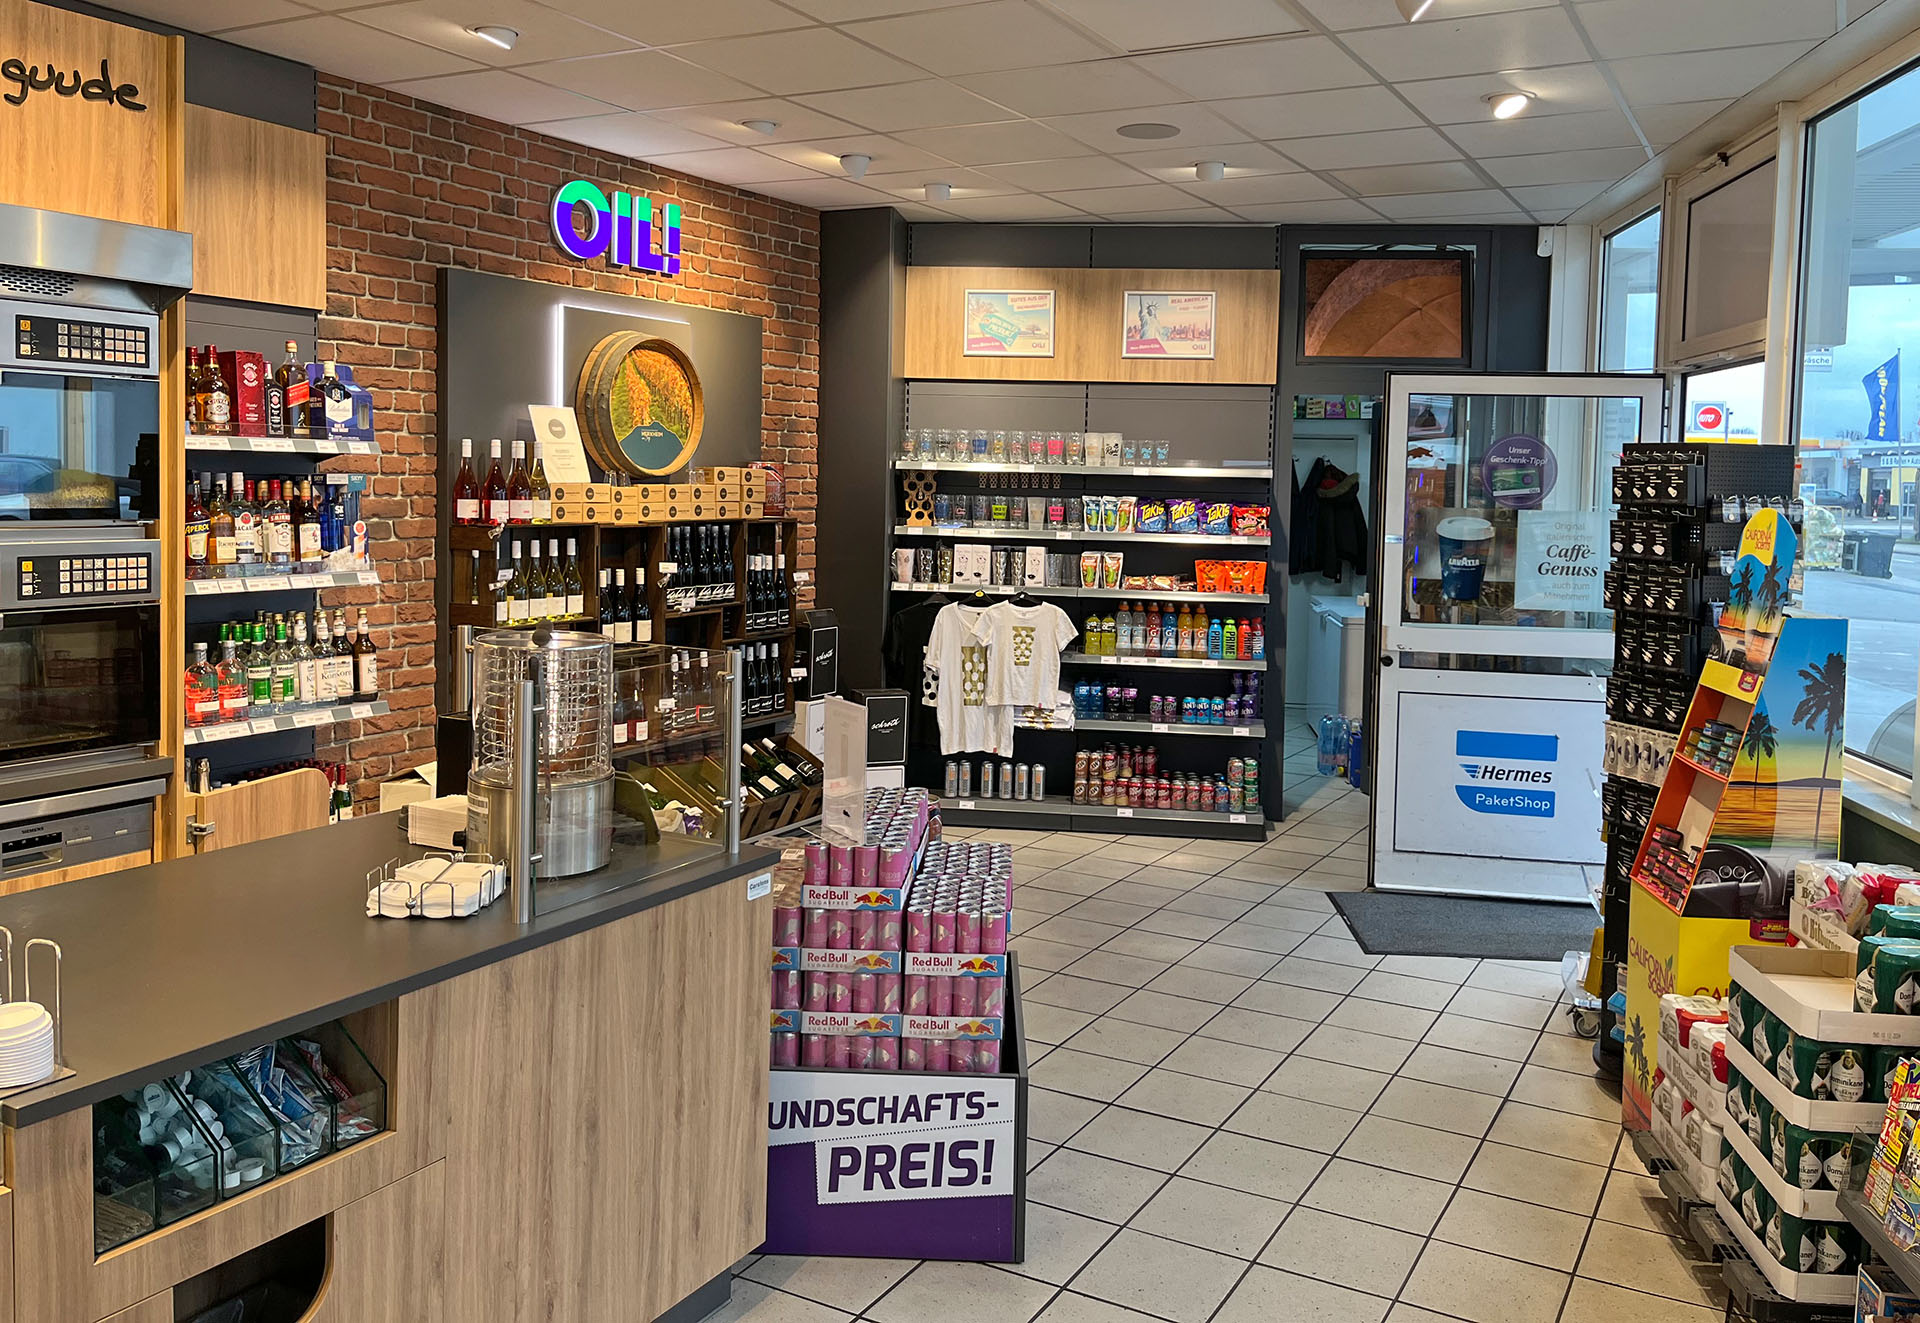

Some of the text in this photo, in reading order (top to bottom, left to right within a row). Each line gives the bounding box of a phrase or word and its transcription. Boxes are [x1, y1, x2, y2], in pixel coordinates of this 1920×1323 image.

[1, 58, 147, 112] guude
[551, 180, 682, 275] OIL!
[1508, 446, 1532, 454] Unser
[1490, 455, 1548, 467] Geschenk-Tipp!
[1141, 503, 1165, 523] Takis
[1170, 500, 1195, 523] Takis
[1206, 503, 1230, 524] Takis
[184, 523, 209, 534] APEROL
[1554, 522, 1585, 534] Original
[1448, 557, 1480, 567] LAVAZZA
[1546, 544, 1596, 562] Caffè-
[1537, 562, 1598, 577] Genuss
[1210, 630, 1220, 655] PRIME
[1225, 630, 1235, 655] PRIME
[1243, 631, 1251, 655] PRIME
[1252, 630, 1262, 655] PRIME
[1211, 703, 1224, 711] FANT
[1481, 765, 1552, 783] Hermes
[1475, 793, 1551, 811] PaketShop
[809, 889, 849, 900] Red Bull
[807, 952, 848, 963] Red Bull
[912, 956, 953, 967] Red Bull
[1629, 936, 1675, 994] CALIFORNIA
[808, 1015, 849, 1026] Red Bull
[909, 1019, 949, 1030] Red Bull
[768, 1091, 999, 1130] UNDSCHAFTS-
[827, 1139, 995, 1193] PREIS!
